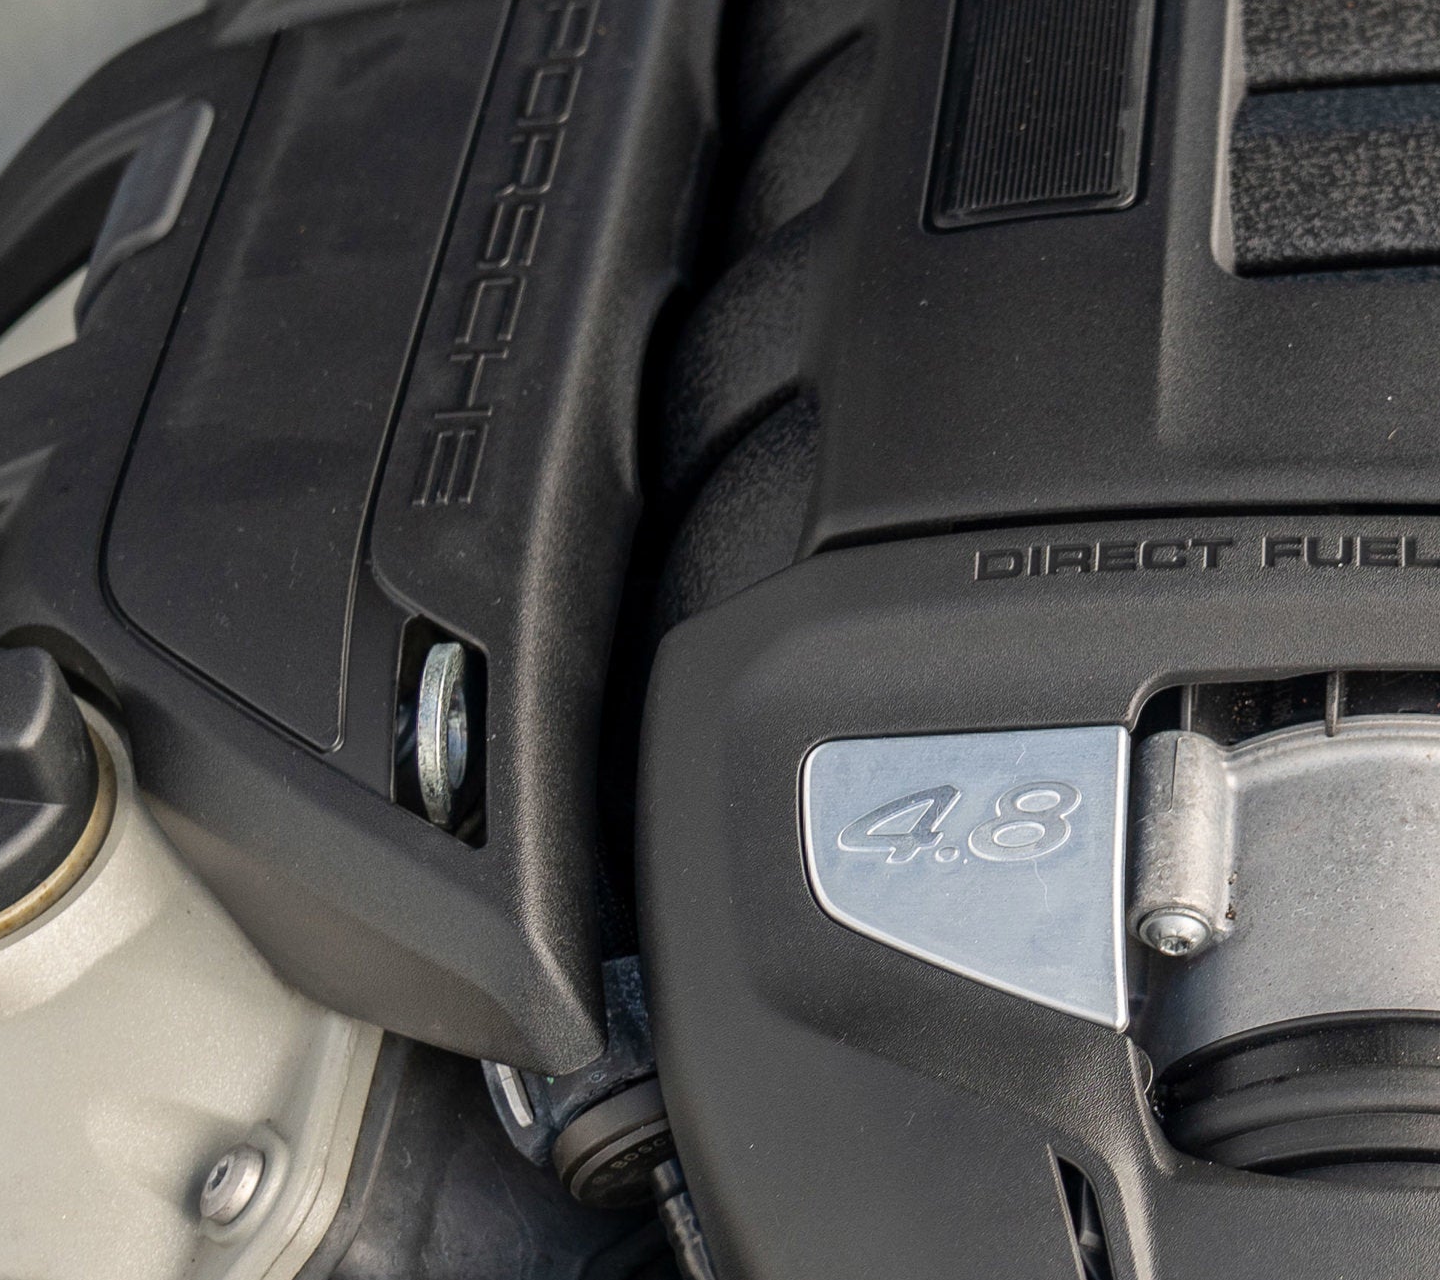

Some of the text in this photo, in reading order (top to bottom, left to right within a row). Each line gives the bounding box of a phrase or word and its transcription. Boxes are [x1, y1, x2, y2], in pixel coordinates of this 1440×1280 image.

[974, 537, 1236, 582] DIRECT
[837, 781, 1084, 866] 4.8
[611, 1136, 672, 1169] BOSC
